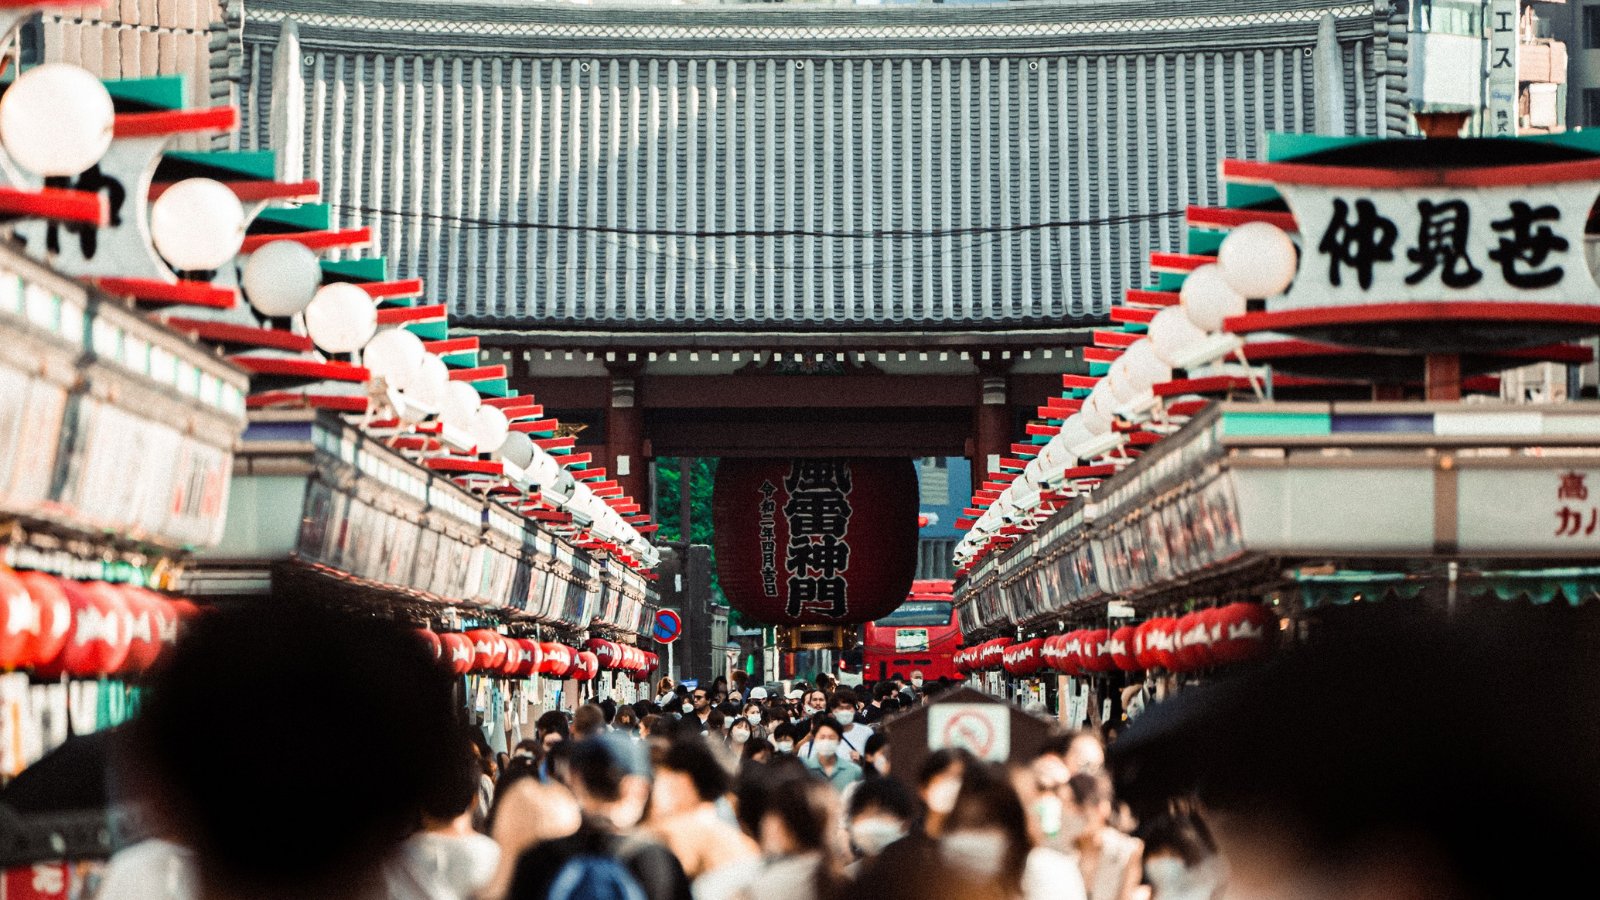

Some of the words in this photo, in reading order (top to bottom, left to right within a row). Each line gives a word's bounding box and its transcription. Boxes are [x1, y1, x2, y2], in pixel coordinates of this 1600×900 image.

[1493, 11, 1513, 68] エス
[1318, 198, 1570, 290] 仲見世
[1558, 471, 1588, 501] 高
[758, 479, 778, 597] 令和二年四月吉日
